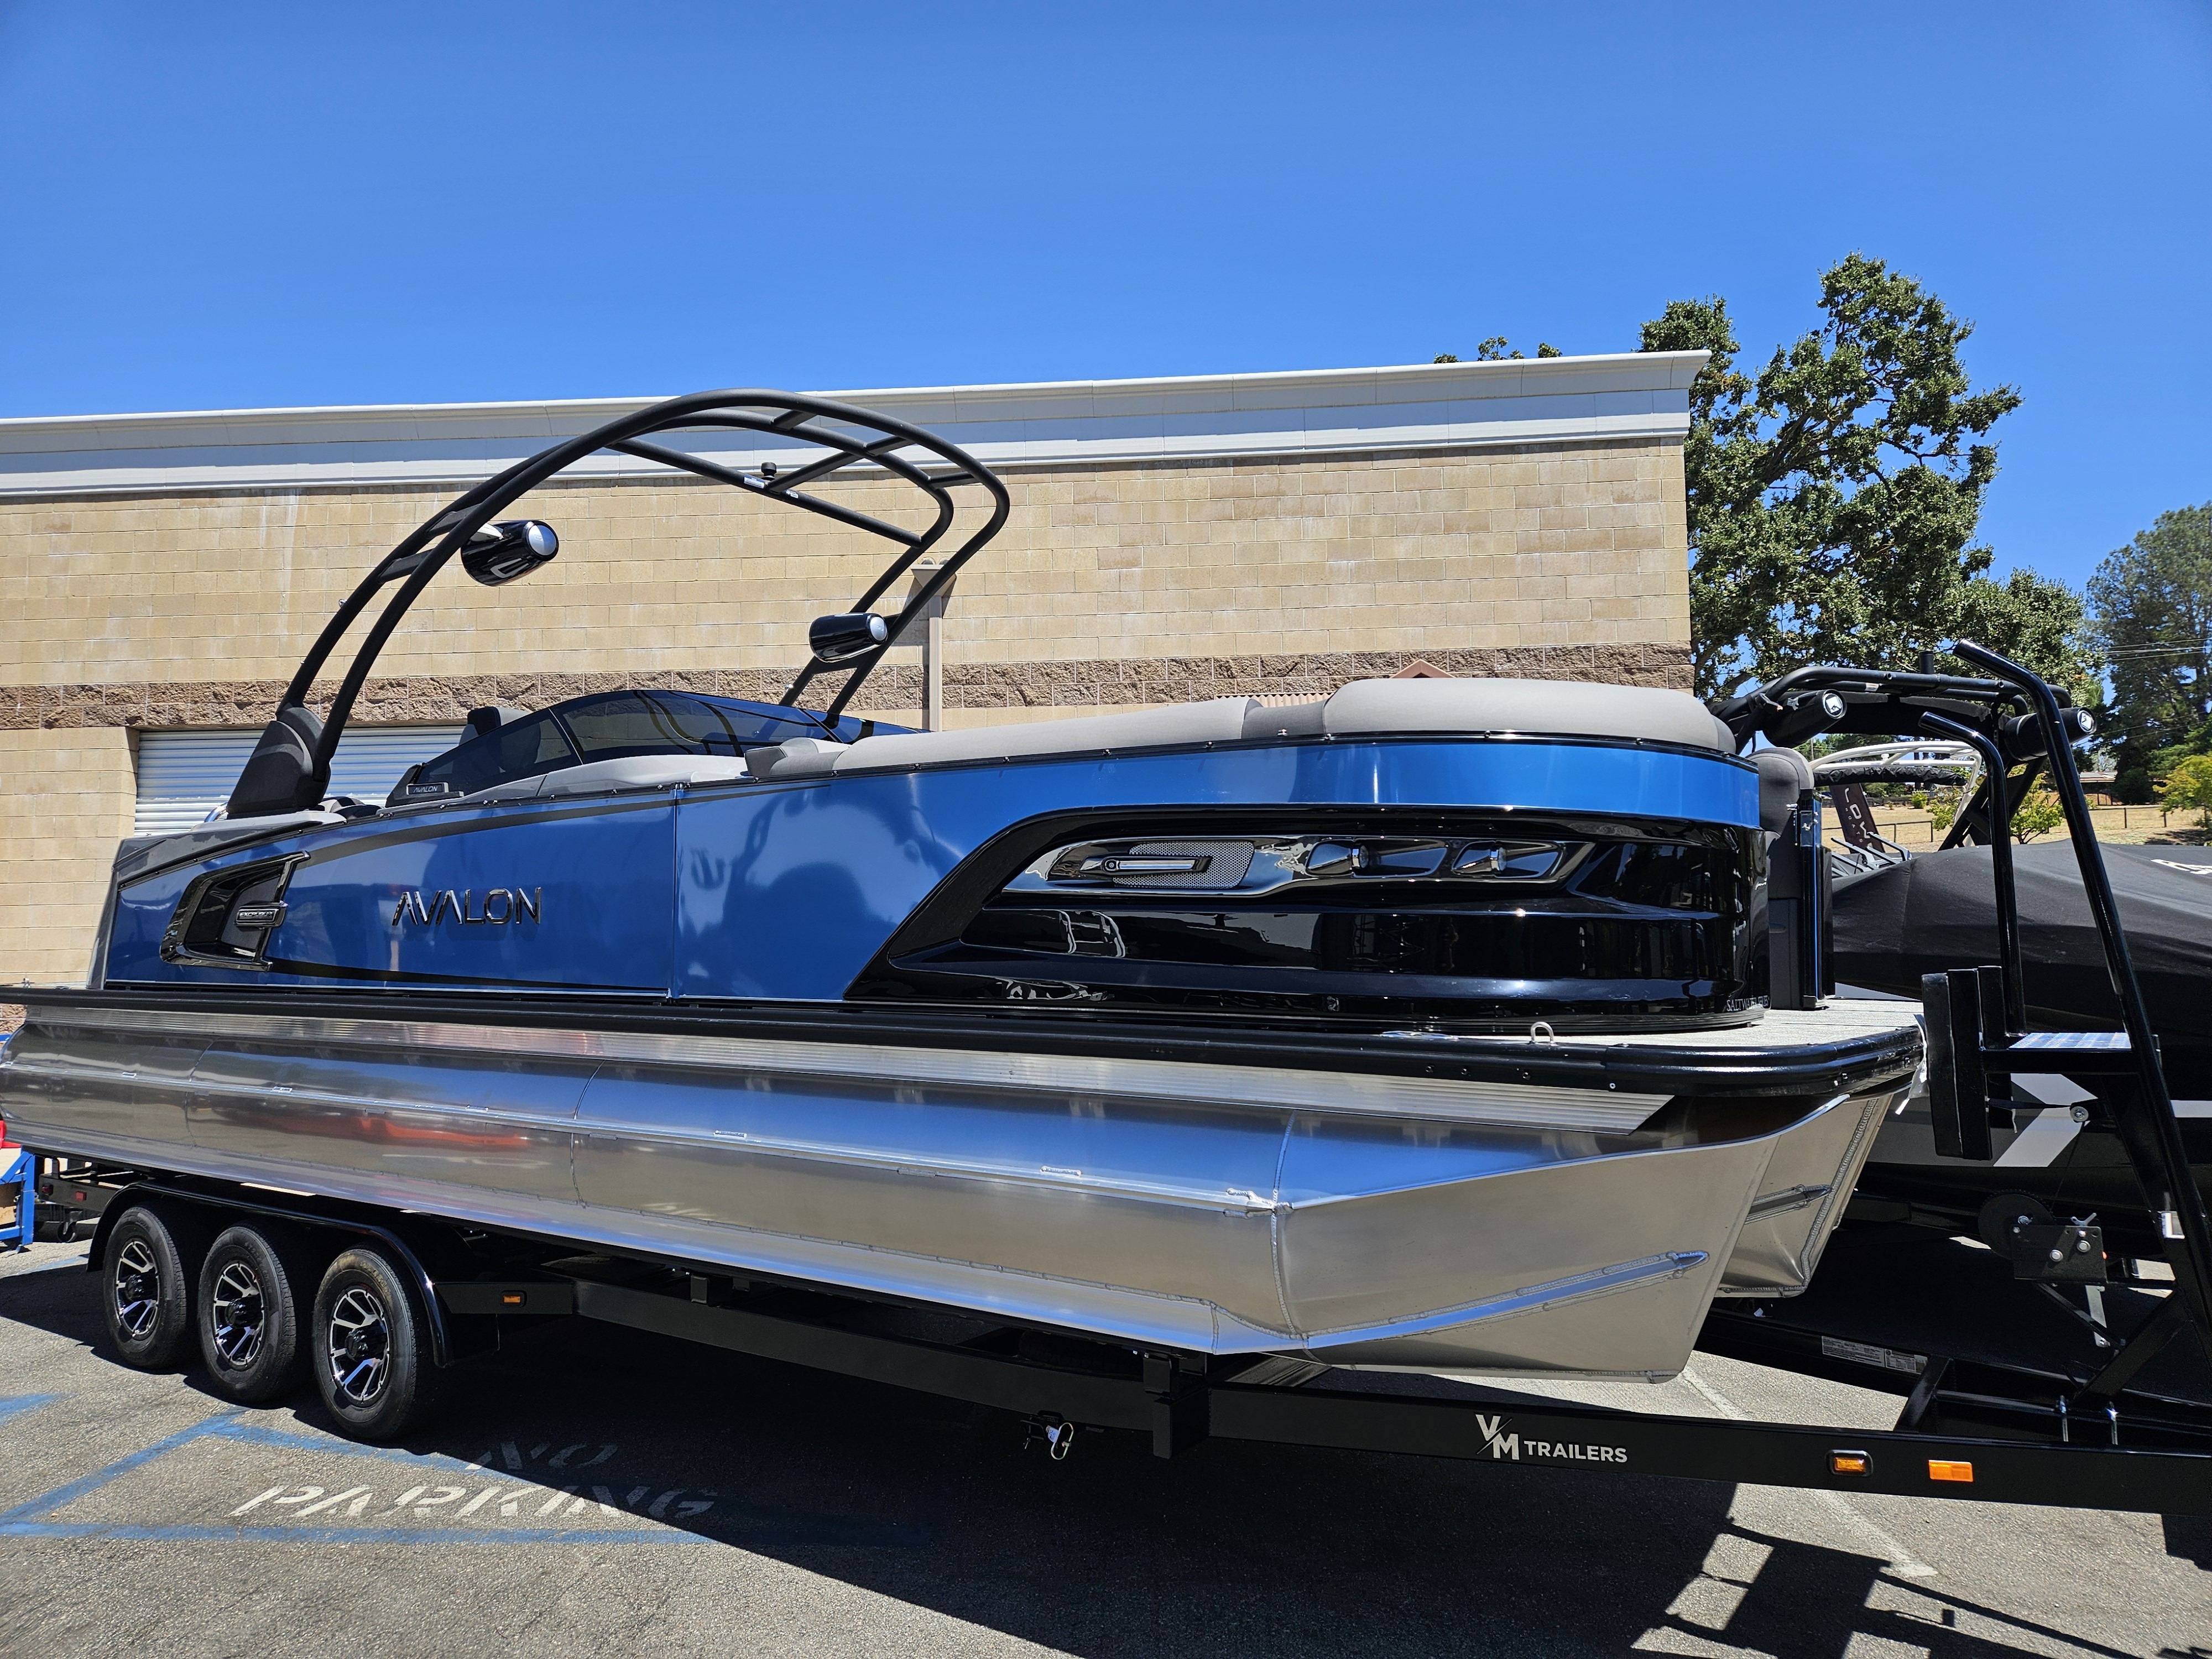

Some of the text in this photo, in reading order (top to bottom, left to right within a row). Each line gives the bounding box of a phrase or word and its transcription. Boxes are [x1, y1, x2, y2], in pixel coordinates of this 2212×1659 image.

[392, 887, 541, 926] AVALON
[465, 1441, 618, 1470] NO
[1524, 1440, 1627, 1463] TRAILERS
[228, 1484, 718, 1519] PARKING
